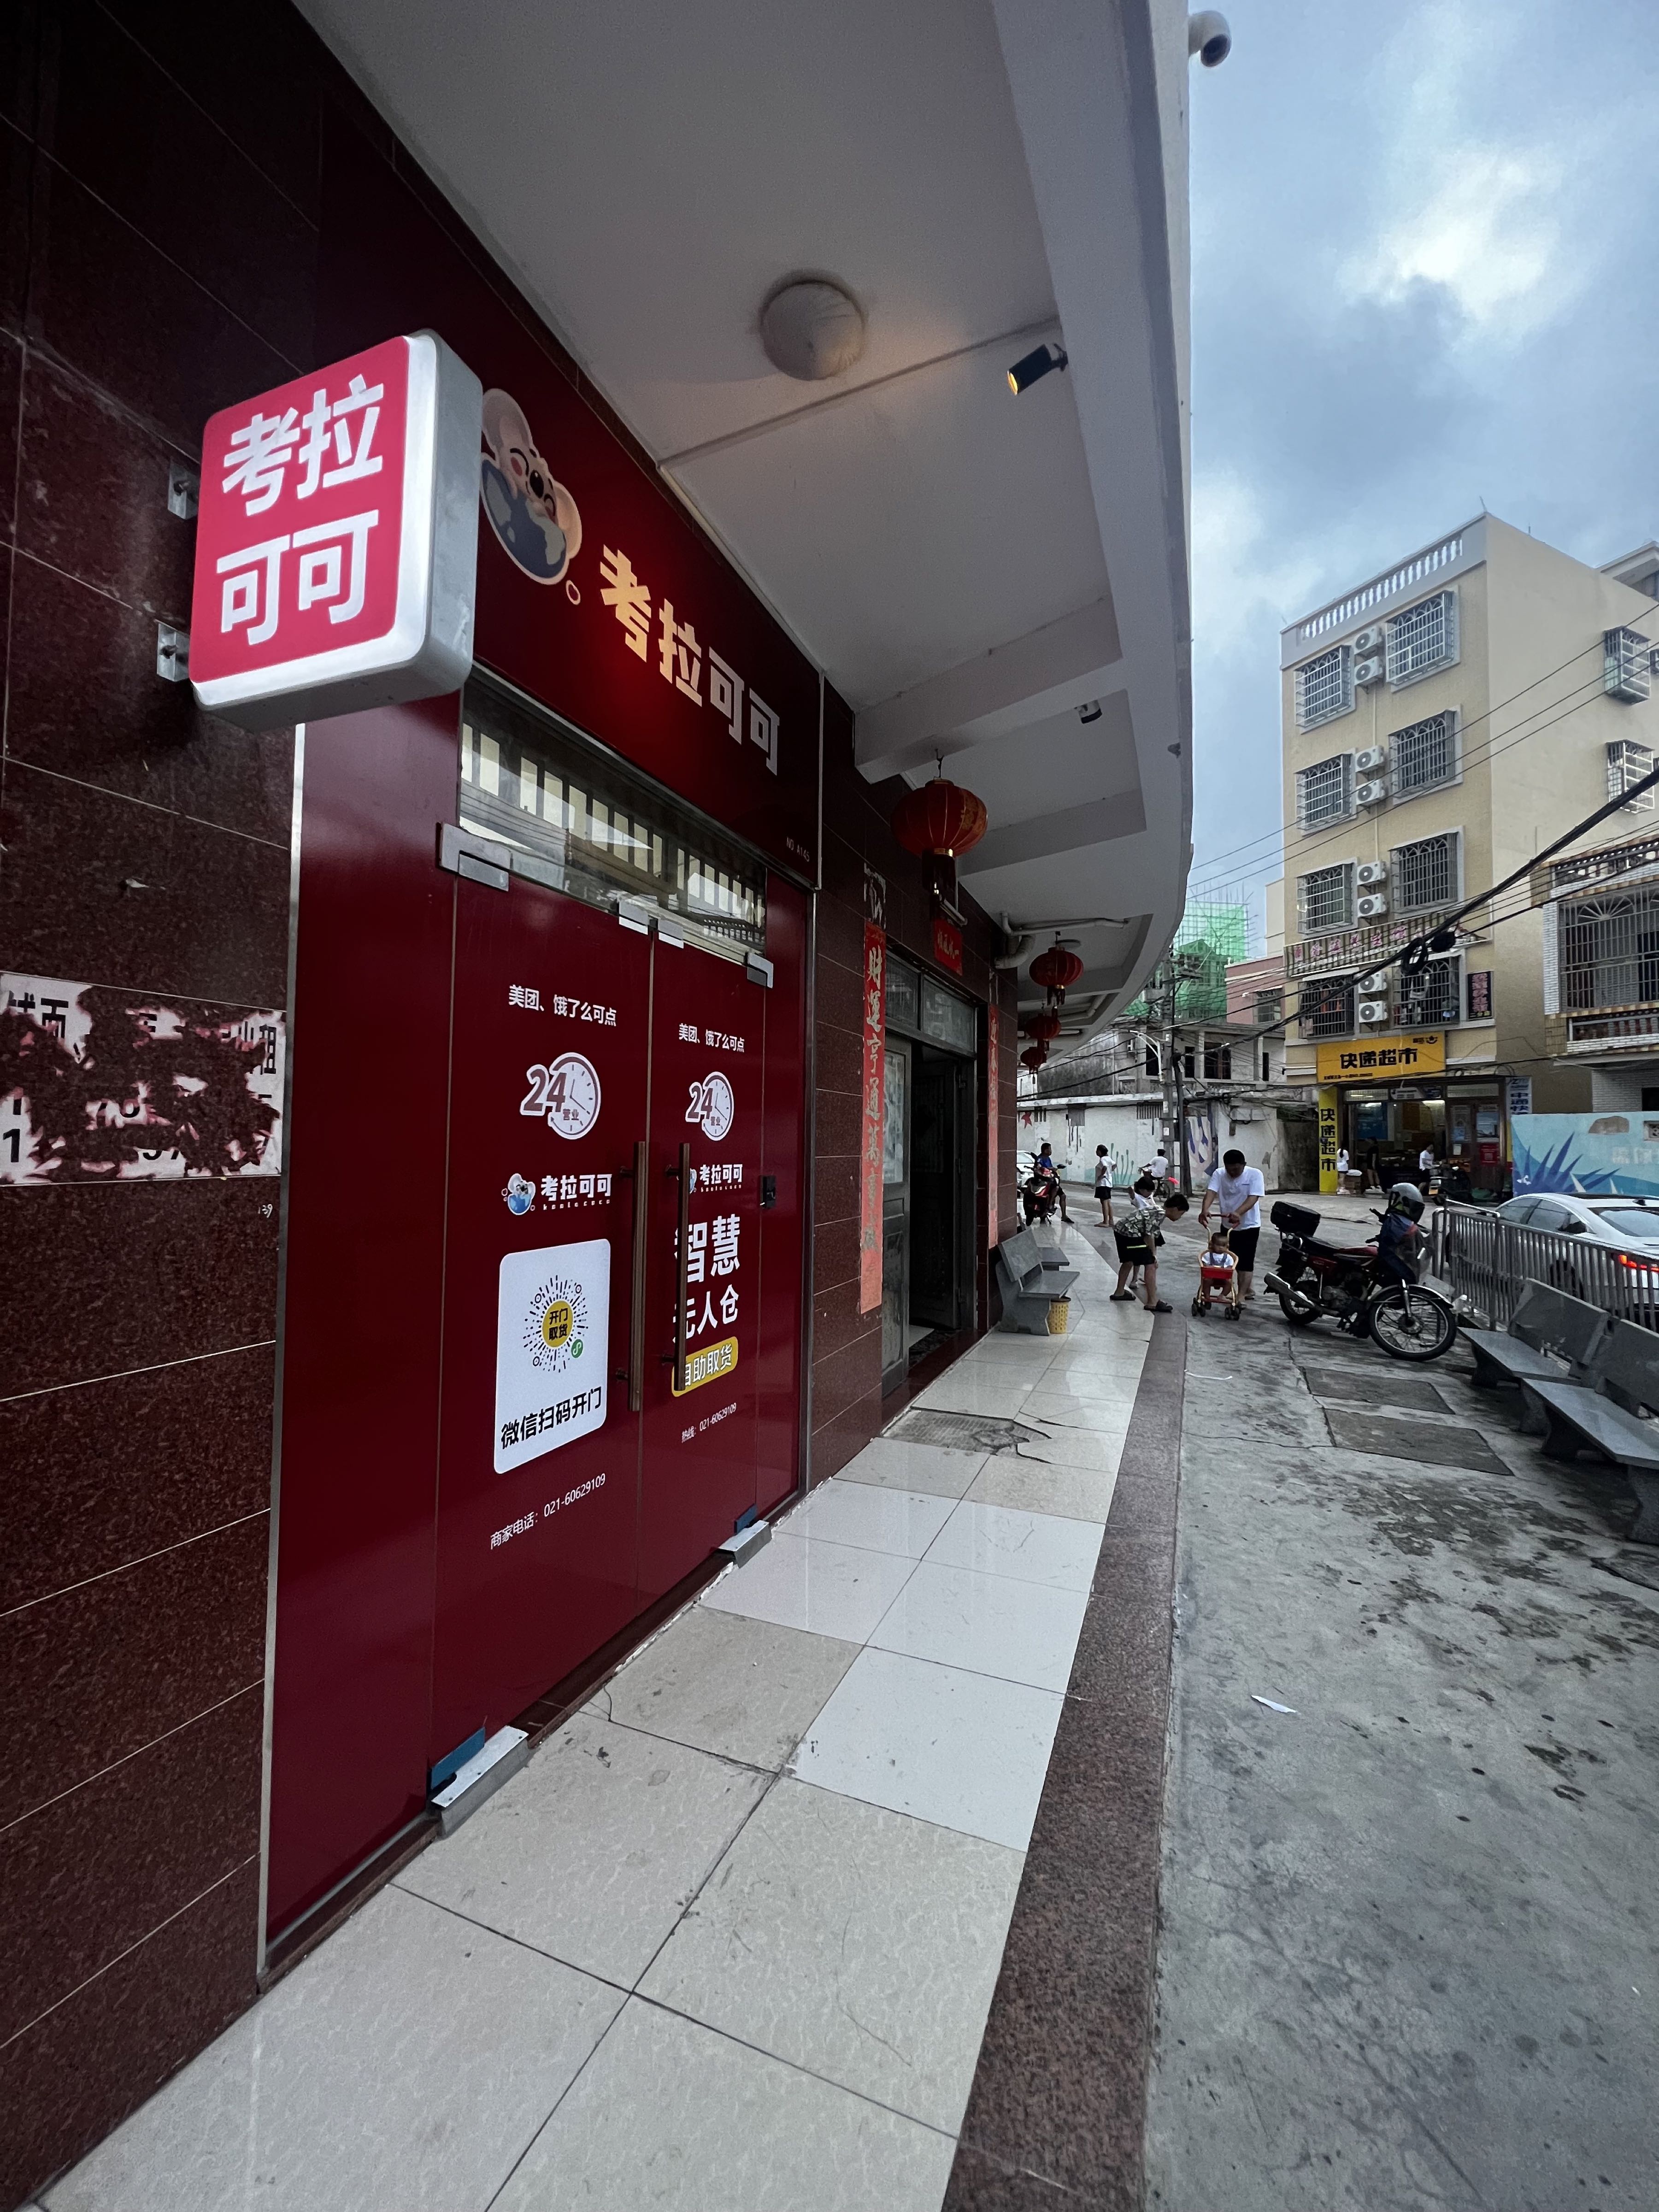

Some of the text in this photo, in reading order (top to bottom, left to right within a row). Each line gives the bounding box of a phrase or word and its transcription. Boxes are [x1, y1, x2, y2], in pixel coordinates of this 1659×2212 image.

[221, 374, 383, 517] 考拉
[216, 509, 379, 645] 可可
[600, 545, 780, 776] 考拉可可
[508, 984, 617, 1026] 美团、饿了么可点
[679, 1023, 745, 1053] 美团、饿了么可点
[1340, 1047, 1418, 1069] 快递超市
[521, 1066, 567, 1114] 24
[686, 1082, 713, 1121] 24
[1320, 1108, 1336, 1171] 快递超市
[541, 1174, 612, 1201] 考拉可可
[699, 1164, 743, 1185] 考拉可可
[674, 1214, 740, 1283] 智慧
[548, 1308, 569, 1324] 开门
[548, 1324, 569, 1341] 取货
[501, 1386, 602, 1450] 微信扫码开门
